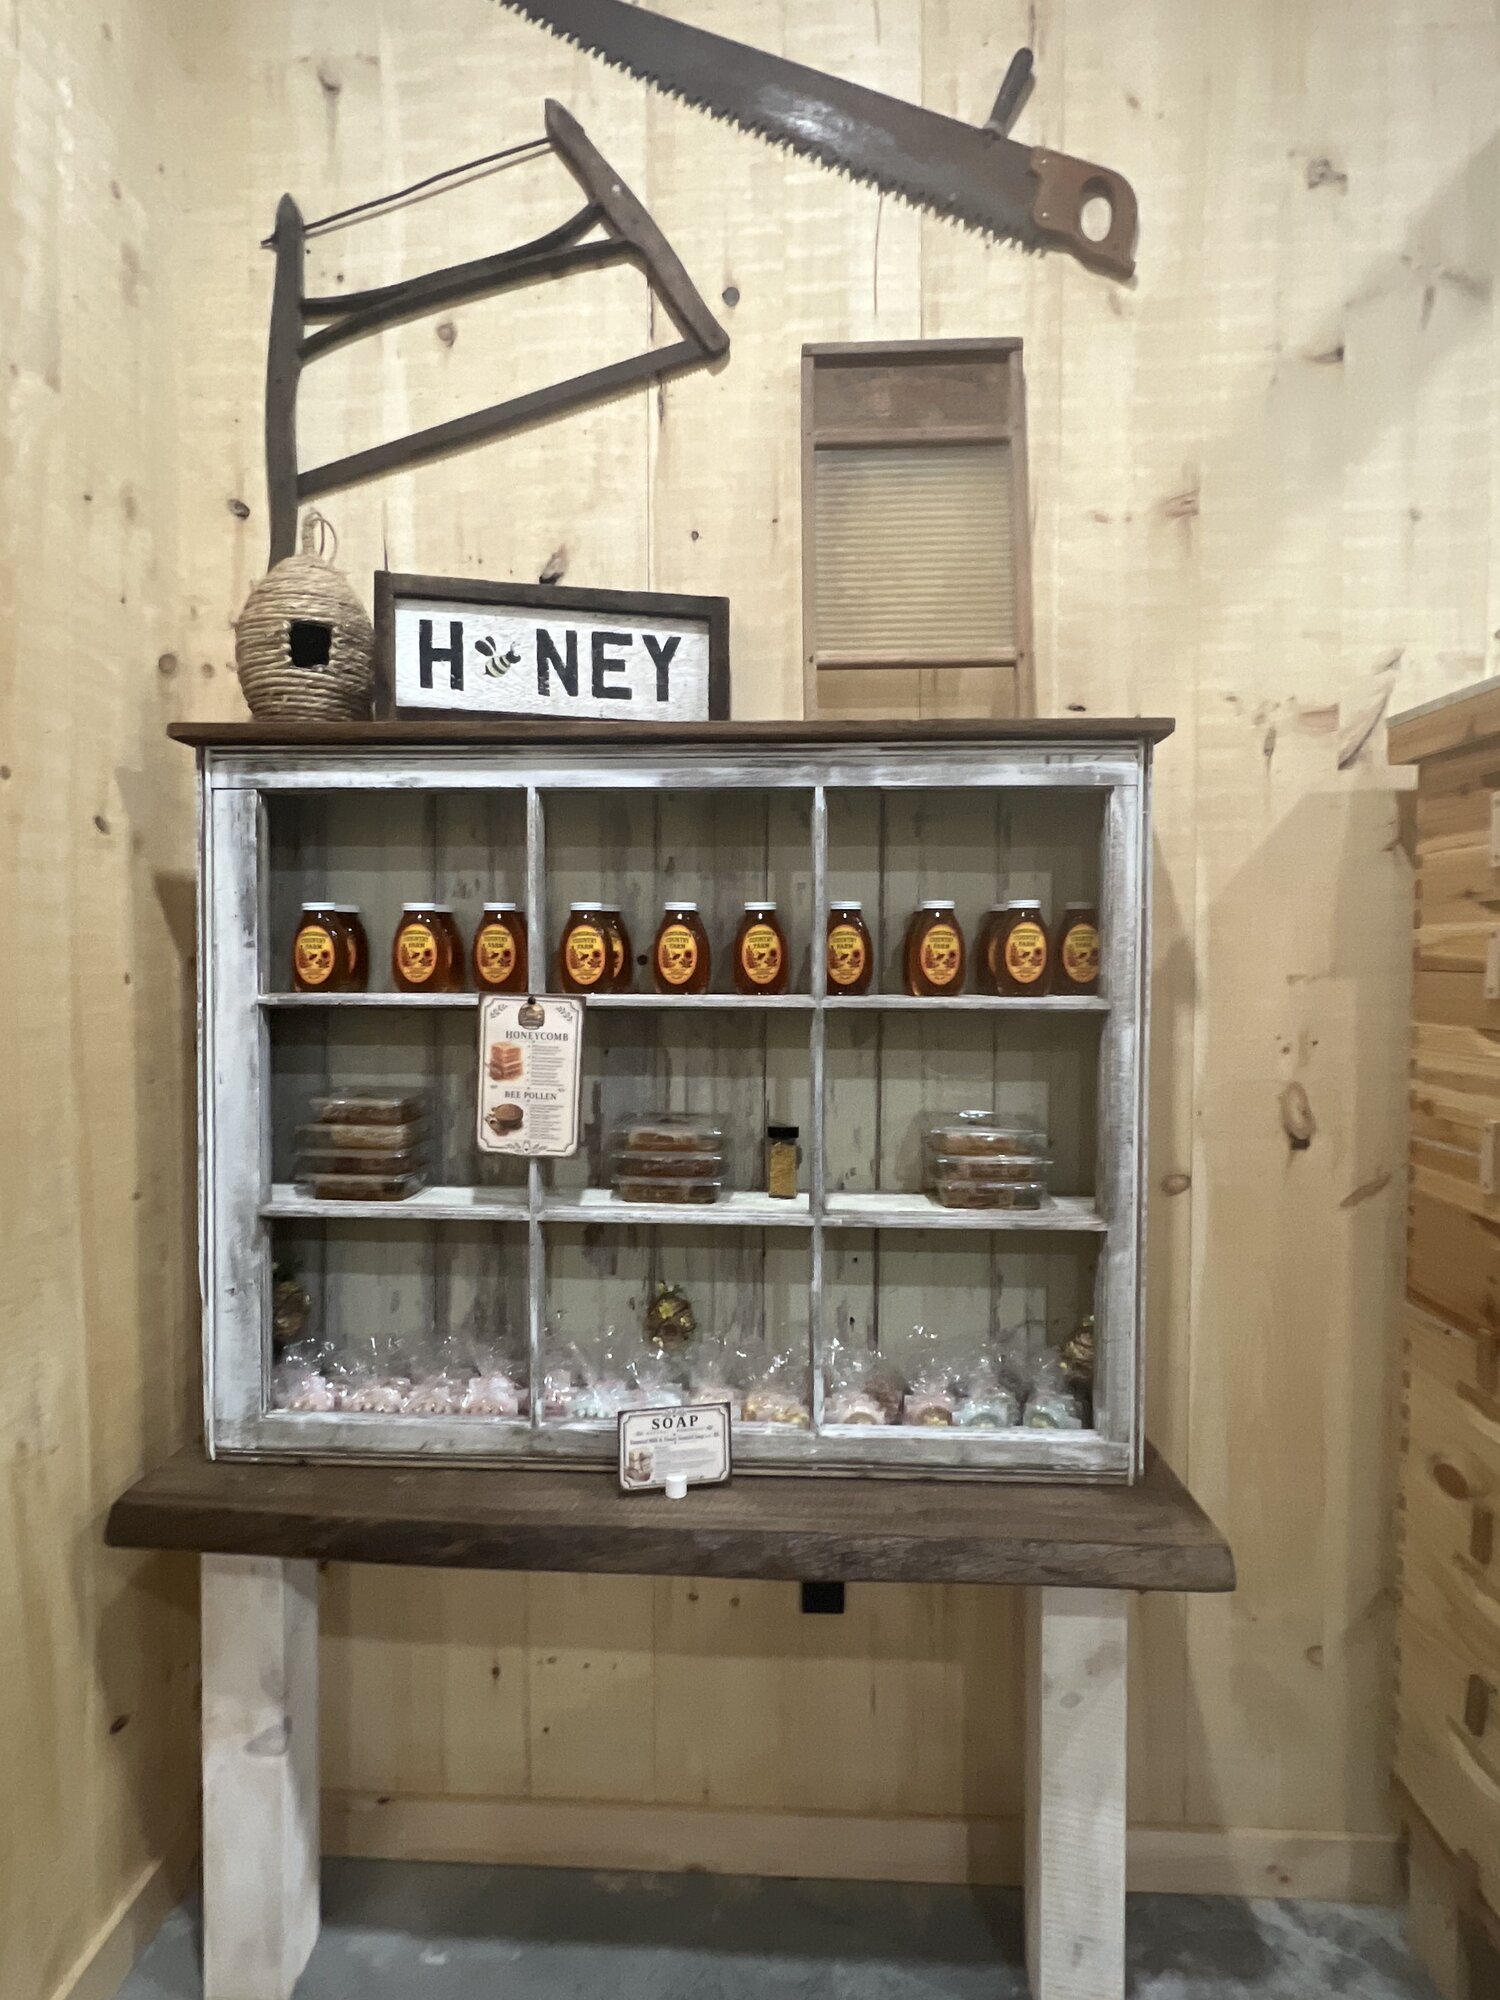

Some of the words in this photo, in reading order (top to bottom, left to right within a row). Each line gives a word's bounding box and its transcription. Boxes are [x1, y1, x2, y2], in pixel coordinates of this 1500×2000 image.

[419, 619, 681, 702] HNEY
[505, 1030, 569, 1041] HONEYCOMB
[504, 1090, 521, 1099] BEE
[524, 1092, 557, 1100] POLLEN
[652, 1415, 698, 1430] SOAP
